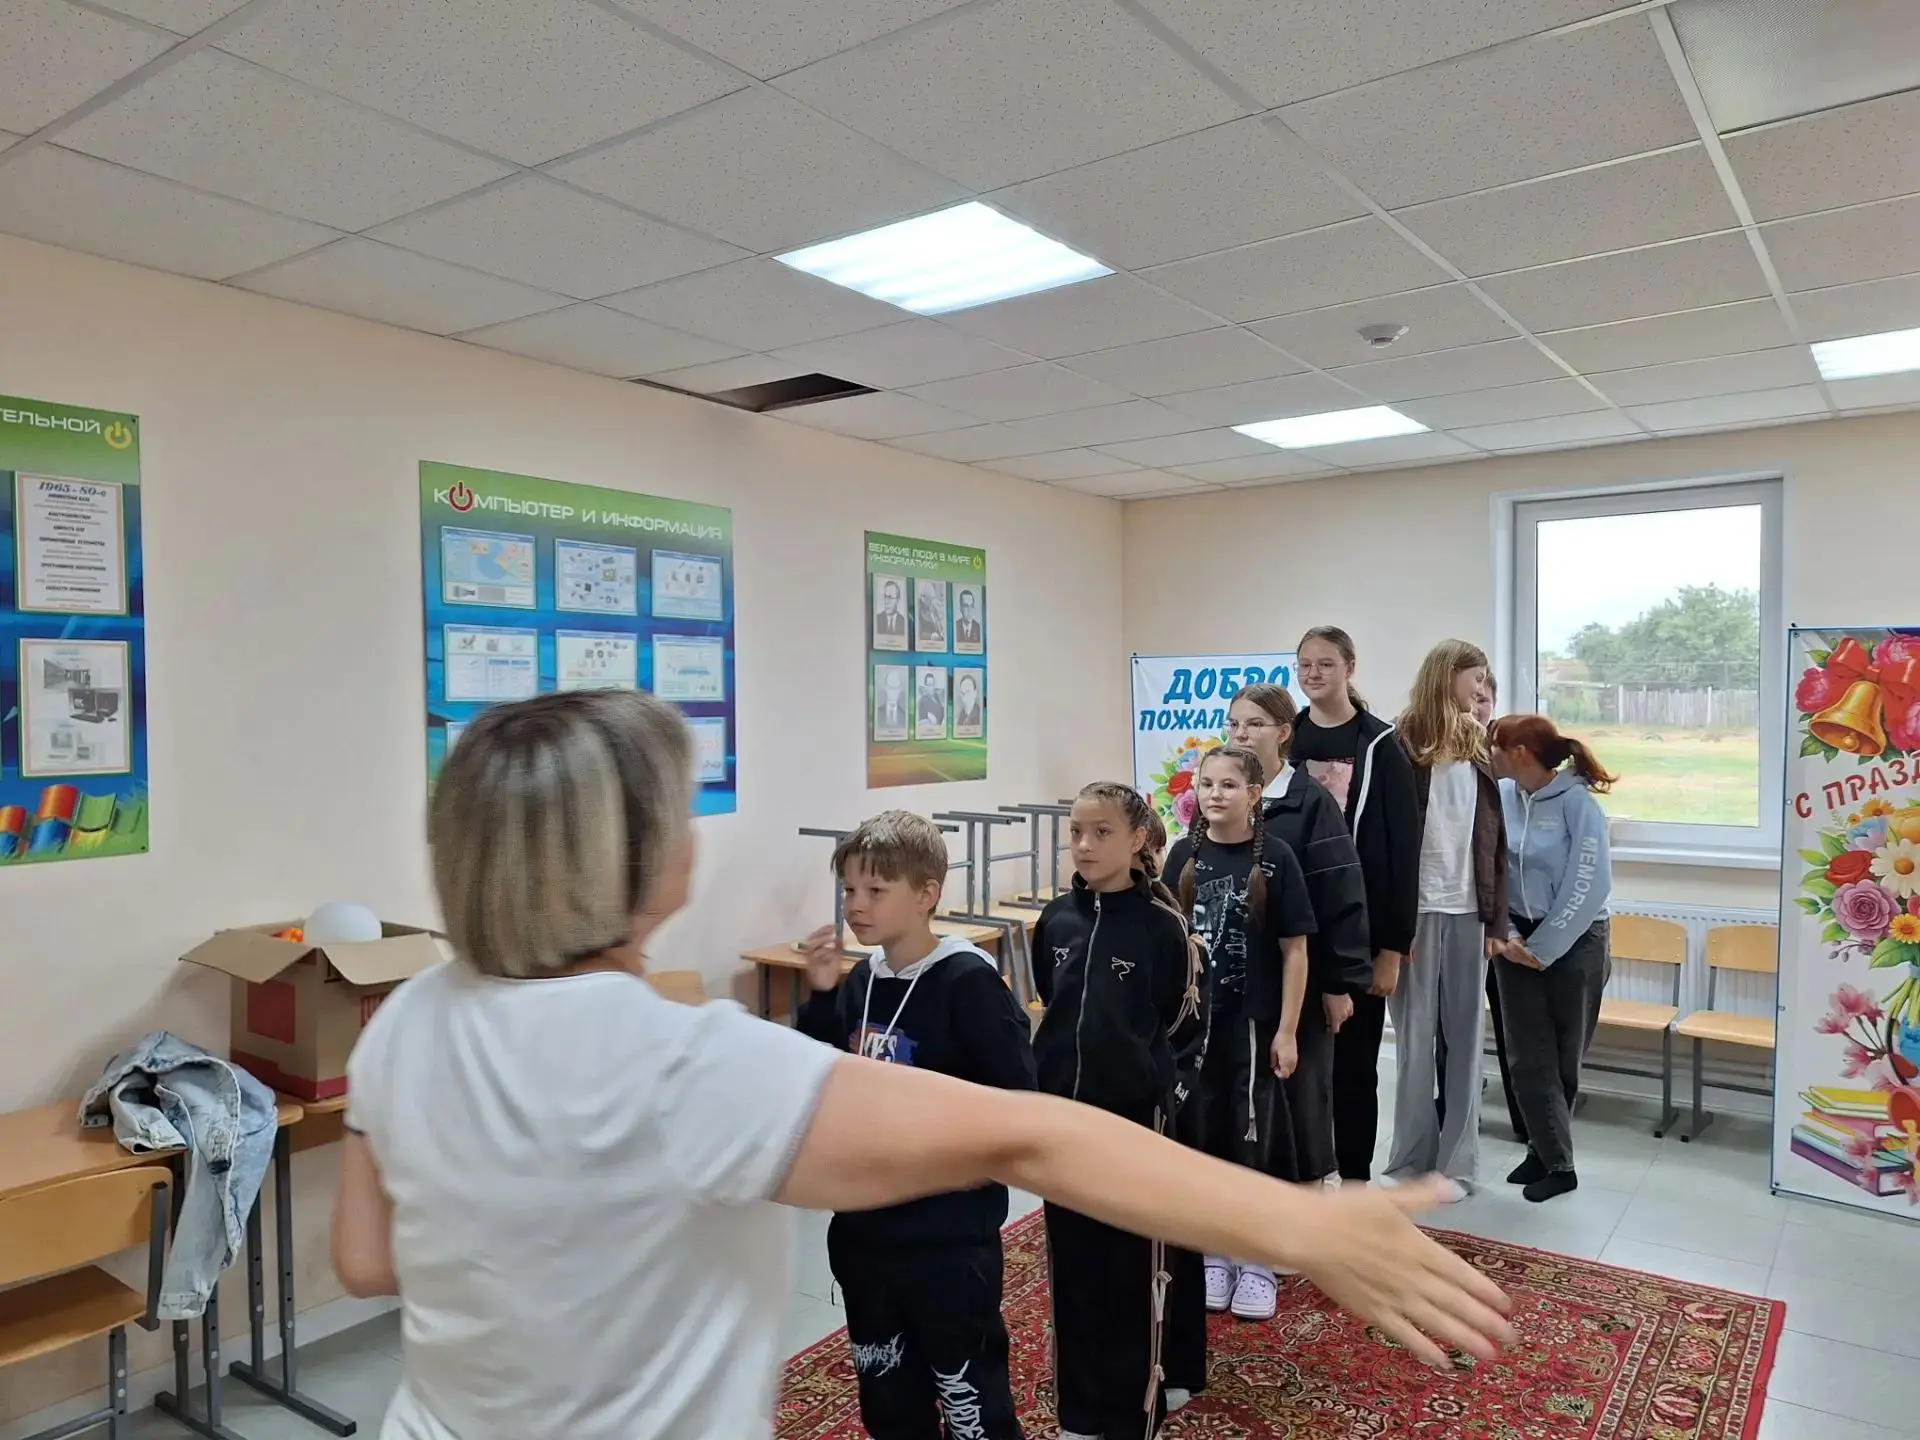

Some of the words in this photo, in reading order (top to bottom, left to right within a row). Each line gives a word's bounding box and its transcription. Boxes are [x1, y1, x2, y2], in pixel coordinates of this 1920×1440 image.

[0, 407, 101, 435] ЕЛЬНОЙ
[433, 480, 574, 519] КОМПЬЮТЕР
[582, 509, 596, 524] И
[602, 511, 723, 540] ИНФОРМАЦИЯ
[868, 542, 910, 556] ВЕЛИКИЕ
[940, 553, 945, 562] В
[948, 555, 971, 565] МИРЕ
[869, 553, 938, 569] ИНФОРМАТИКИ
[1162, 665, 1290, 704] ДОБРО
[1138, 708, 1226, 731] ПОЖАЛ
[1795, 792, 1812, 819] С
[1550, 836, 1598, 930] MEMORIES
